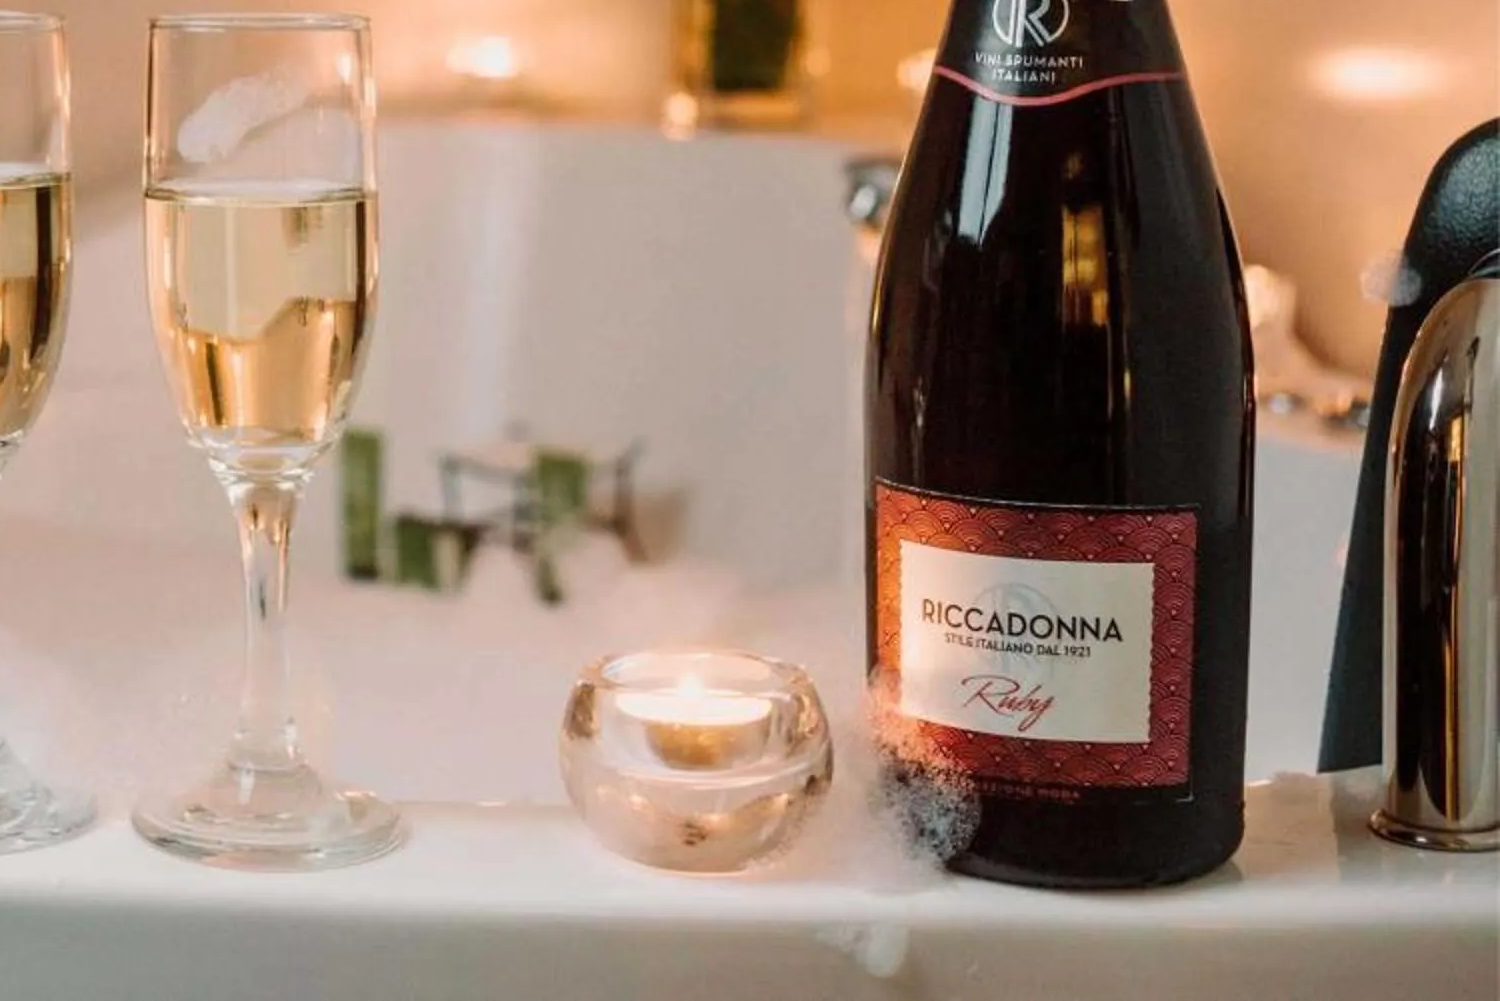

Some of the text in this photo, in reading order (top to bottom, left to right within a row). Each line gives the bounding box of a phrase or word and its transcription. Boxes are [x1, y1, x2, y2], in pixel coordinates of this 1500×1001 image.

[975, 51, 1084, 69] VINI SPUMANTI
[992, 69, 1056, 84] ITALIANI
[921, 598, 1124, 642] RICCADONNA
[944, 632, 1091, 657] STILE ITALIANO DAL 1921
[961, 674, 1055, 732] Ruby
